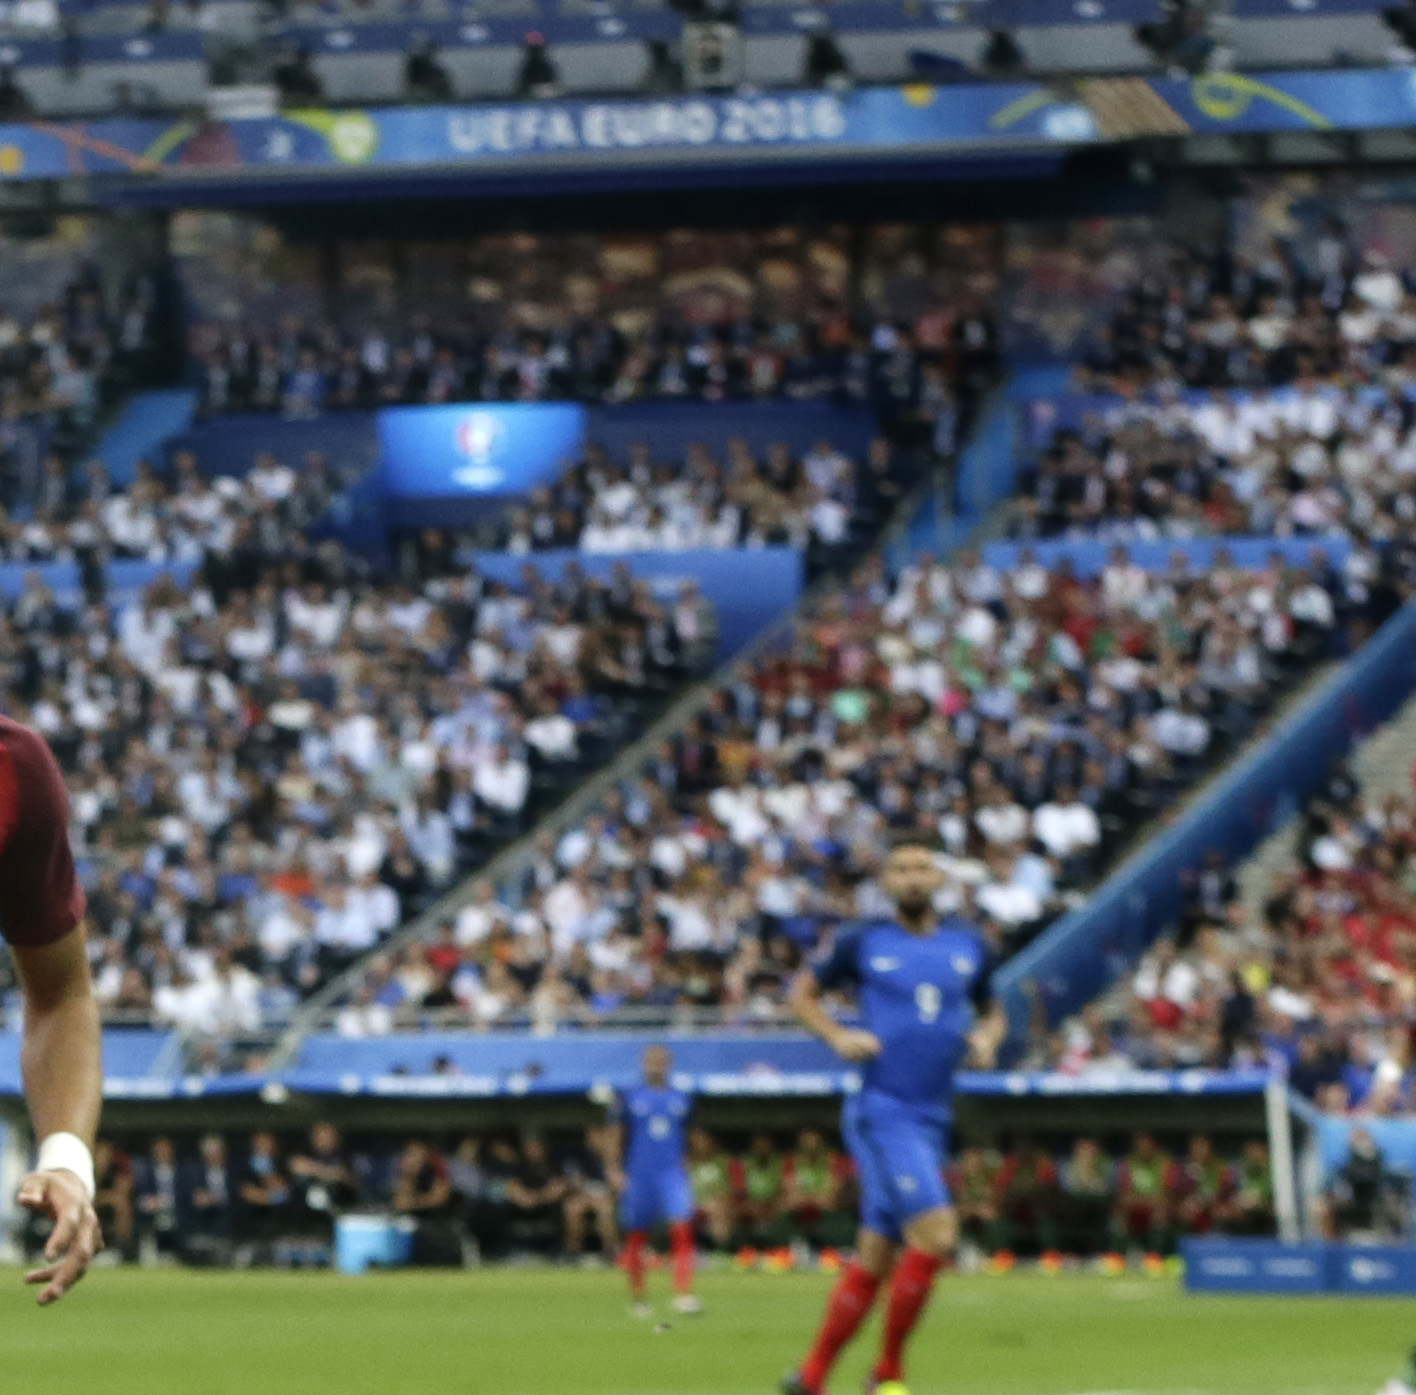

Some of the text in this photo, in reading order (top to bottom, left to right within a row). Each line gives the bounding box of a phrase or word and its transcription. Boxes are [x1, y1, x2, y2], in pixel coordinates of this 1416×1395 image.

[447, 98, 846, 152] UEFA EURO 2016
